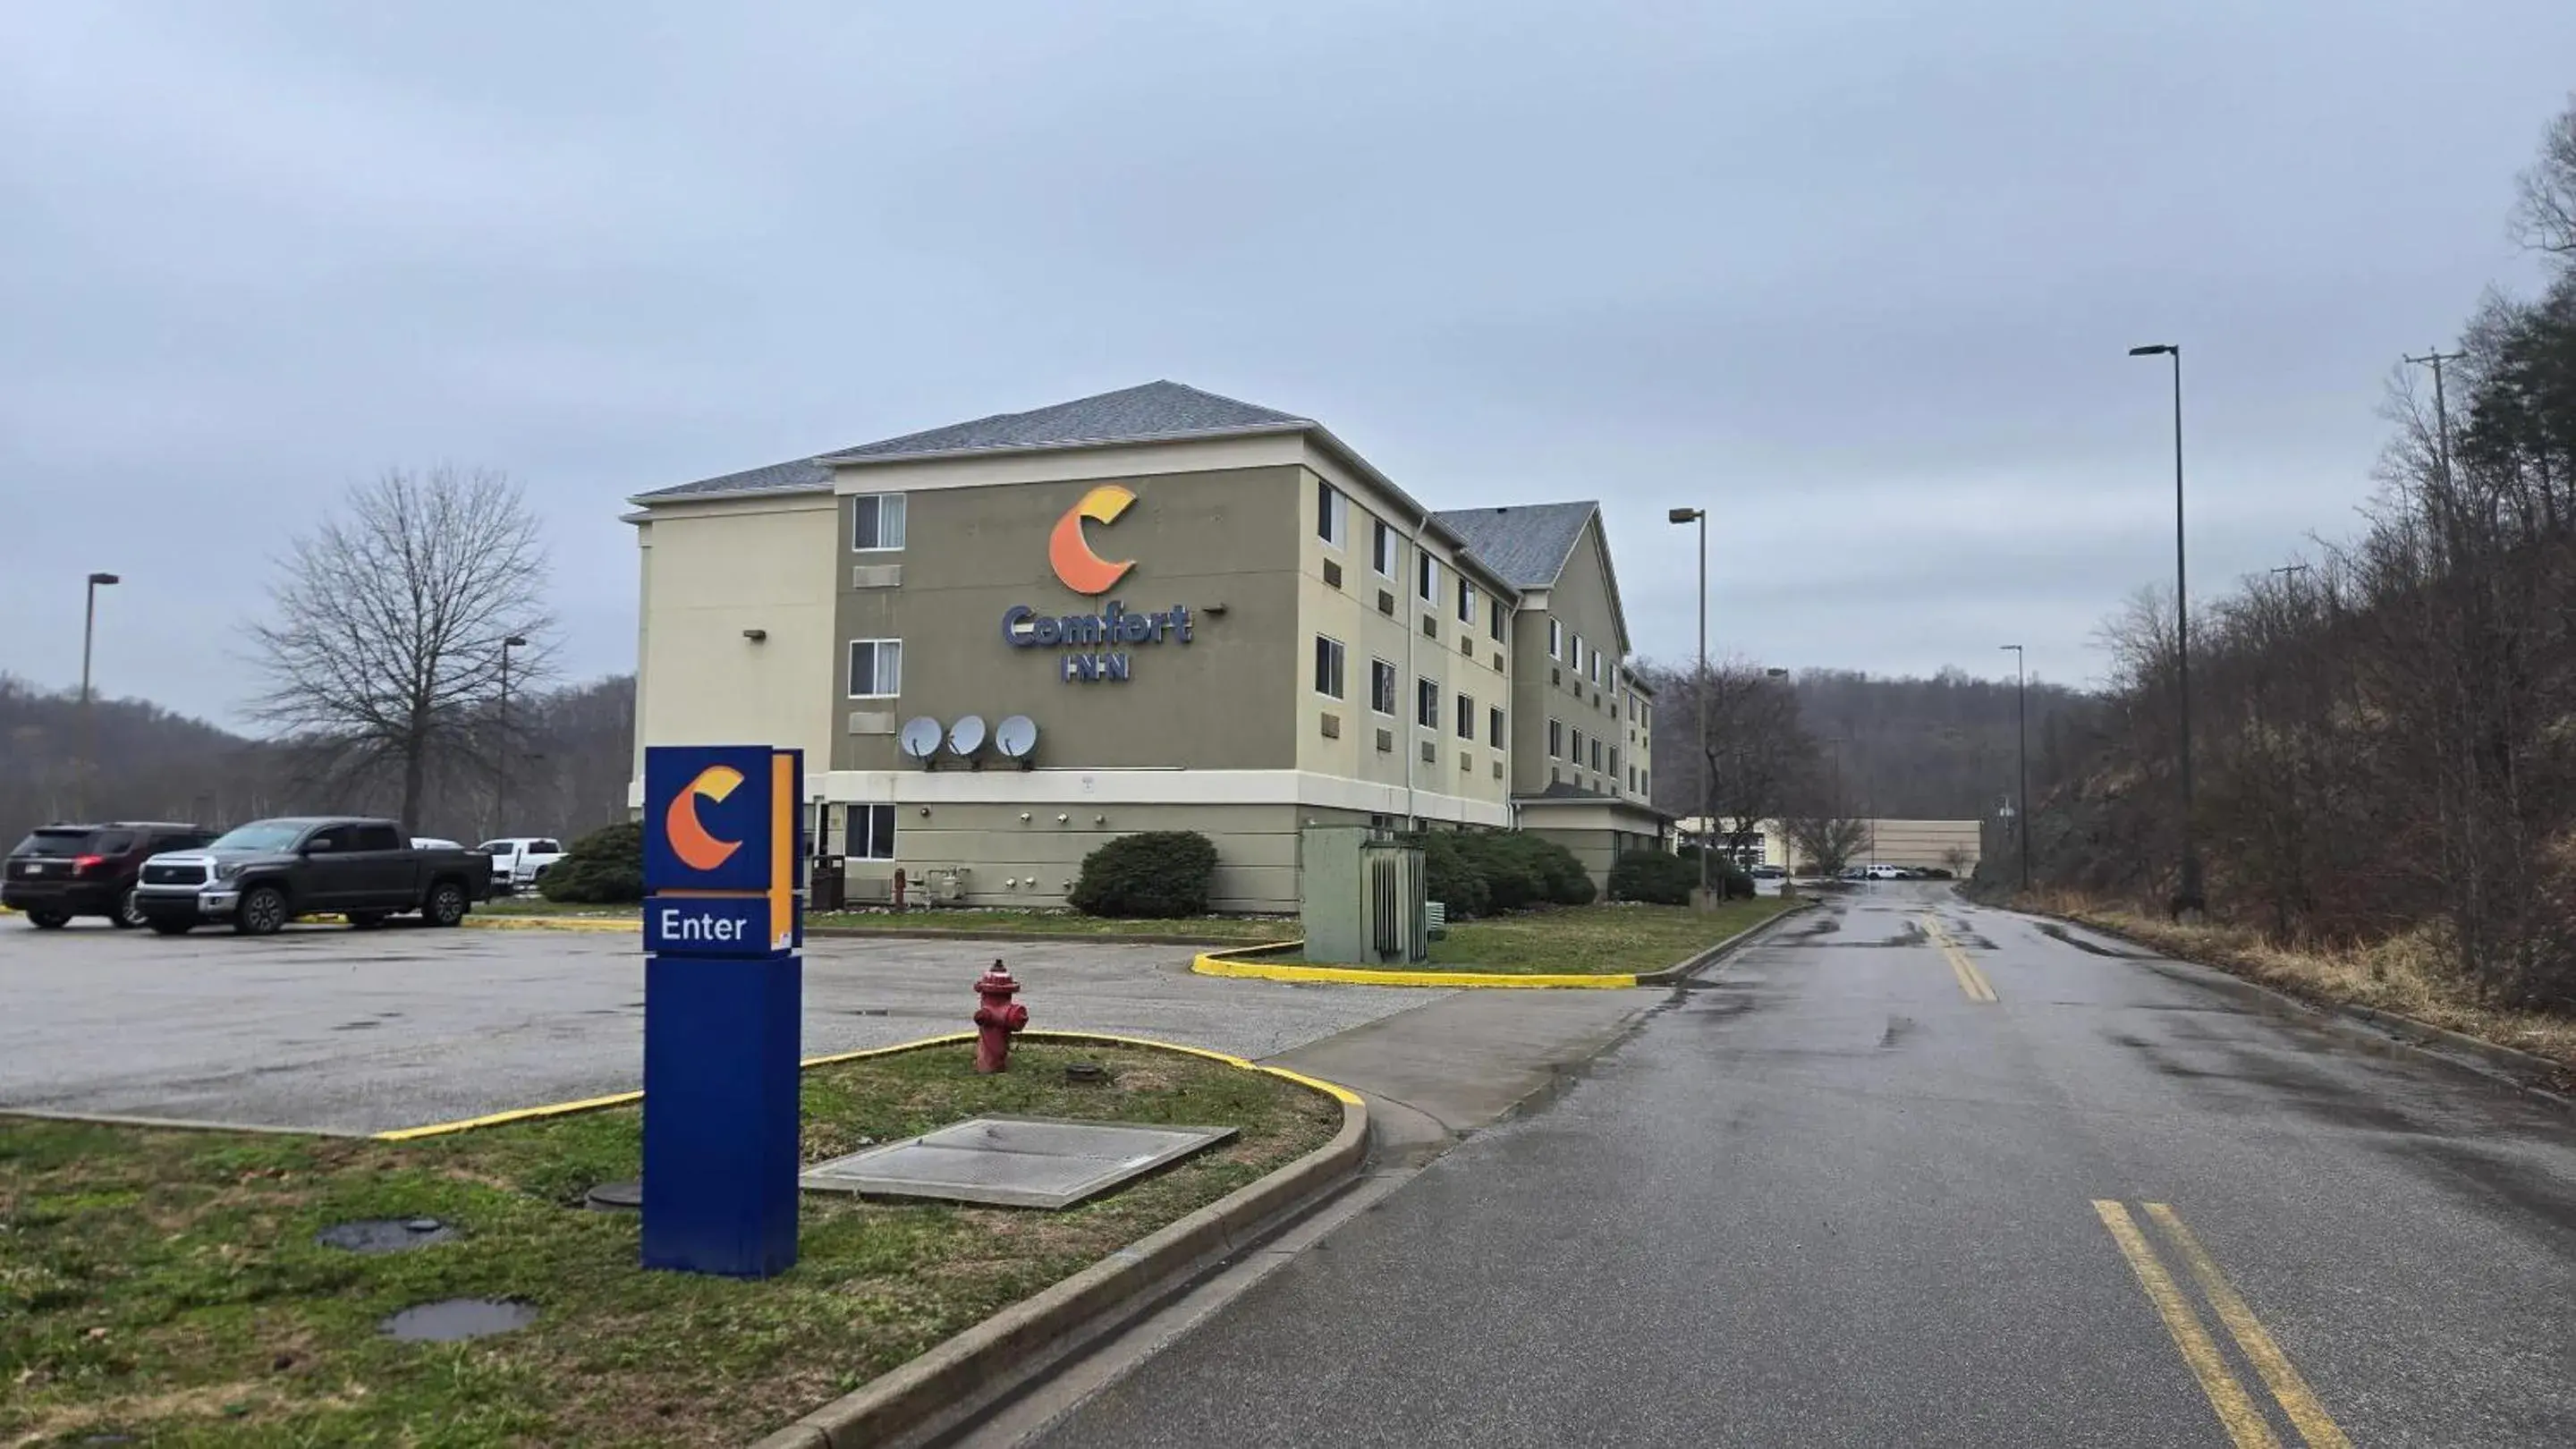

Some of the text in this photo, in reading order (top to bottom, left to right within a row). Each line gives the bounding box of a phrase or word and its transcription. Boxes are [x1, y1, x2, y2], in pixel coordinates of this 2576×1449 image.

[1003, 600, 1193, 646] Comfort
[1061, 654, 1129, 682] INN
[662, 909, 747, 940] Enter
